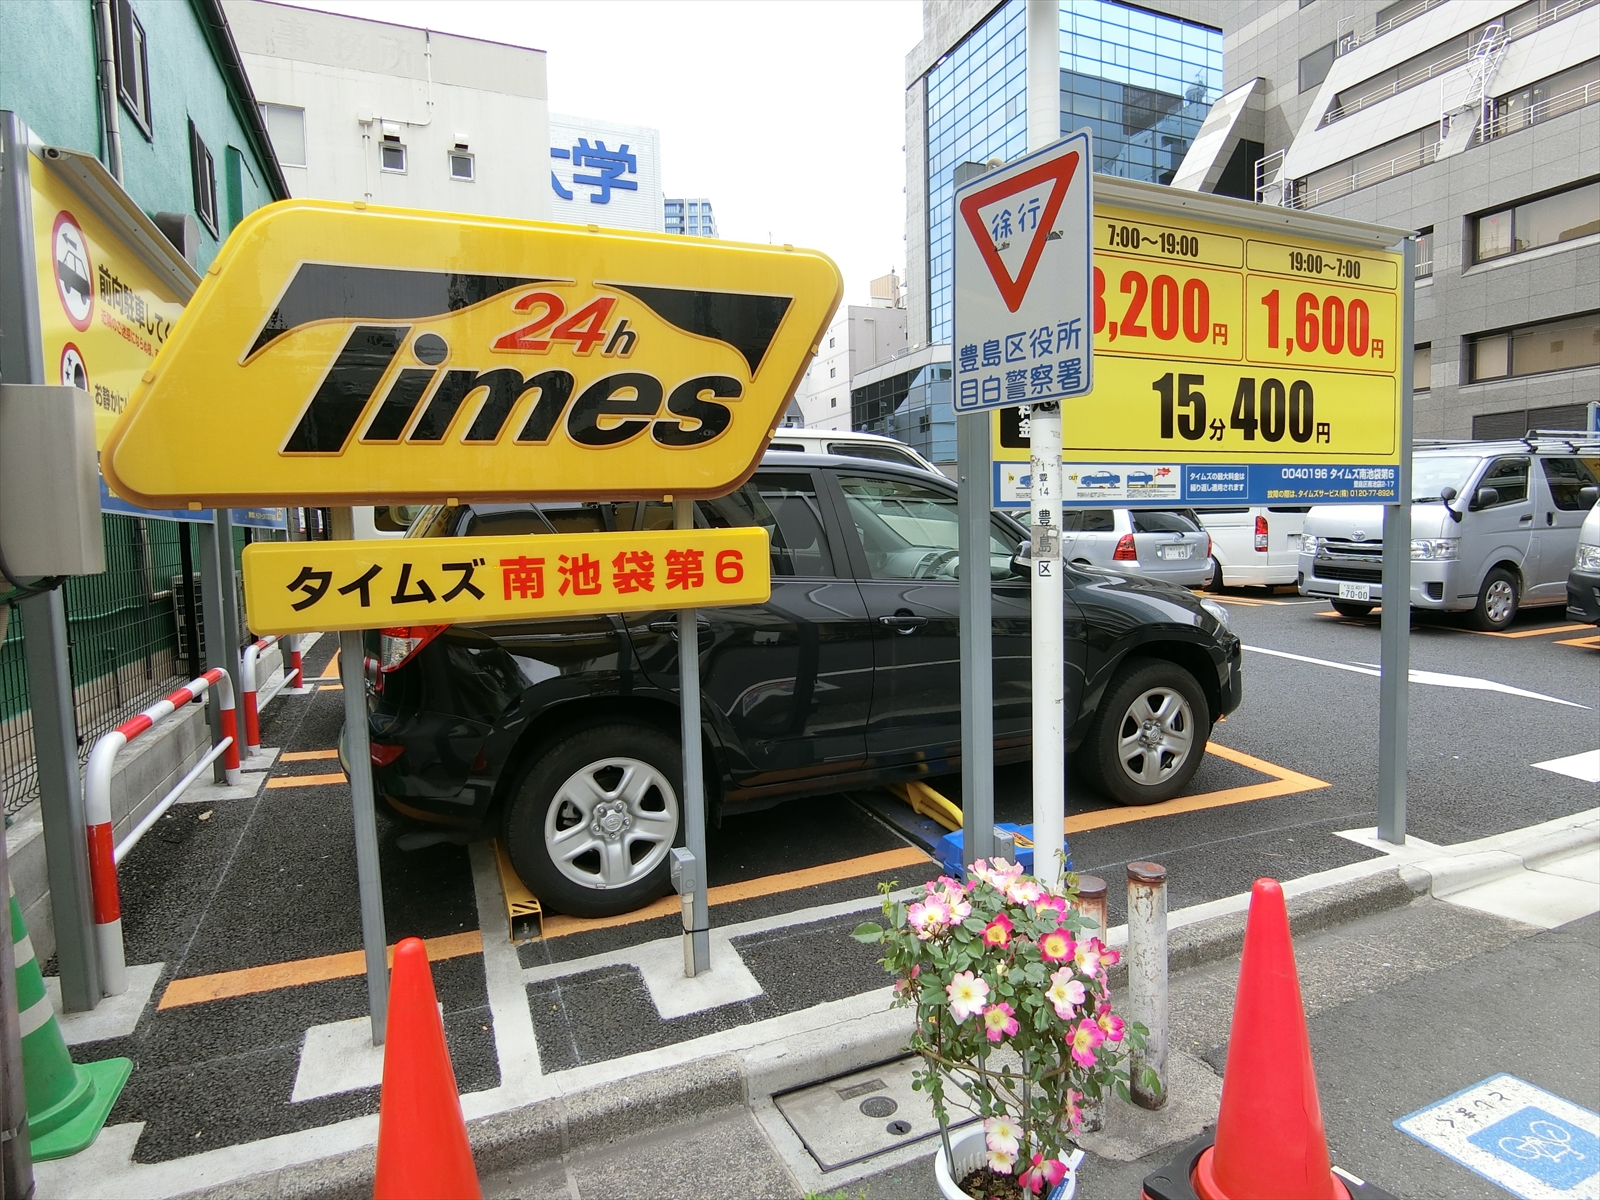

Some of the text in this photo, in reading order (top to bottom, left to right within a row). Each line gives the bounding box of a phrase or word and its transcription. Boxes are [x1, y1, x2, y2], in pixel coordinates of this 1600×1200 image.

[991, 197, 1041, 242] 徐行
[493, 291, 636, 357] 24h
[959, 317, 1082, 374] 豊島区役所
[1261, 289, 1384, 359] 1,600円
[280, 321, 746, 455] Times
[960, 357, 1082, 407] 目白警察署
[1190, 472, 1245, 480] タイムズの最大料金は
[1281, 468, 1394, 480] 0040196 タイムズ南池袋第6
[1345, 589, 1367, 599] 70-00
